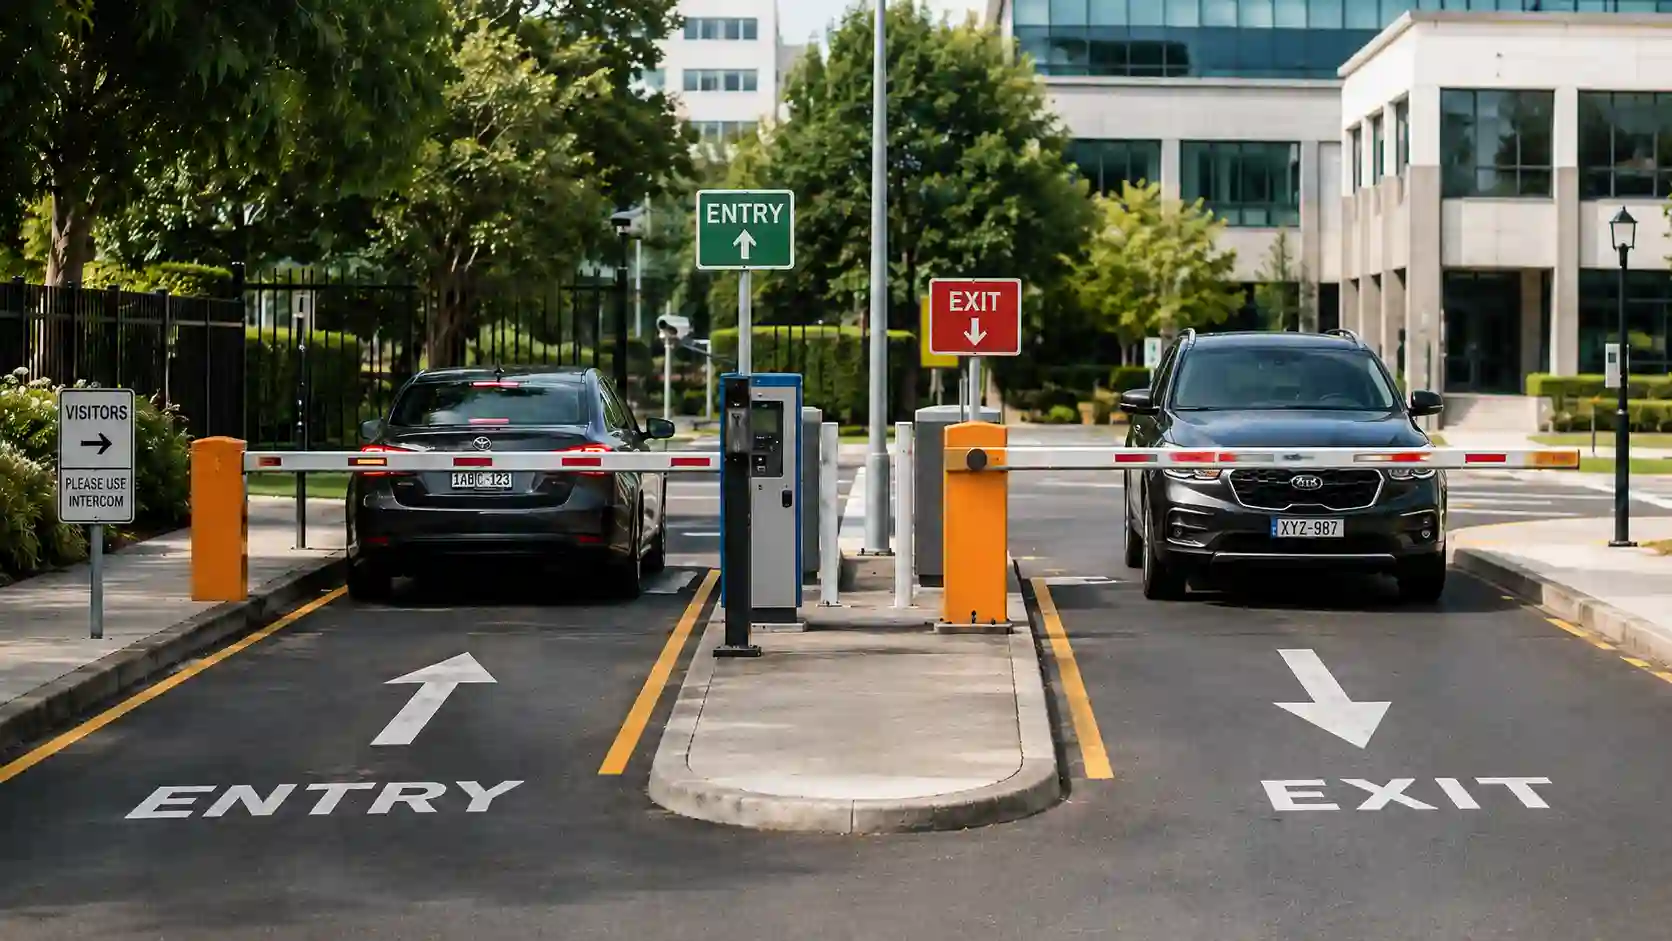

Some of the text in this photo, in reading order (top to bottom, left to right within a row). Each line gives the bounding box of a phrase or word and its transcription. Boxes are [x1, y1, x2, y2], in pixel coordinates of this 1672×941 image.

[706, 203, 784, 224] ENTRY
[949, 291, 1001, 312] EXIT
[65, 405, 128, 421] VISITORS
[65, 477, 127, 490] PLEASE USE
[69, 495, 124, 508] INTERCOM
[1281, 520, 1338, 535] XYZ-987
[124, 780, 525, 819] ENTRY
[1260, 776, 1553, 811] EXIT
